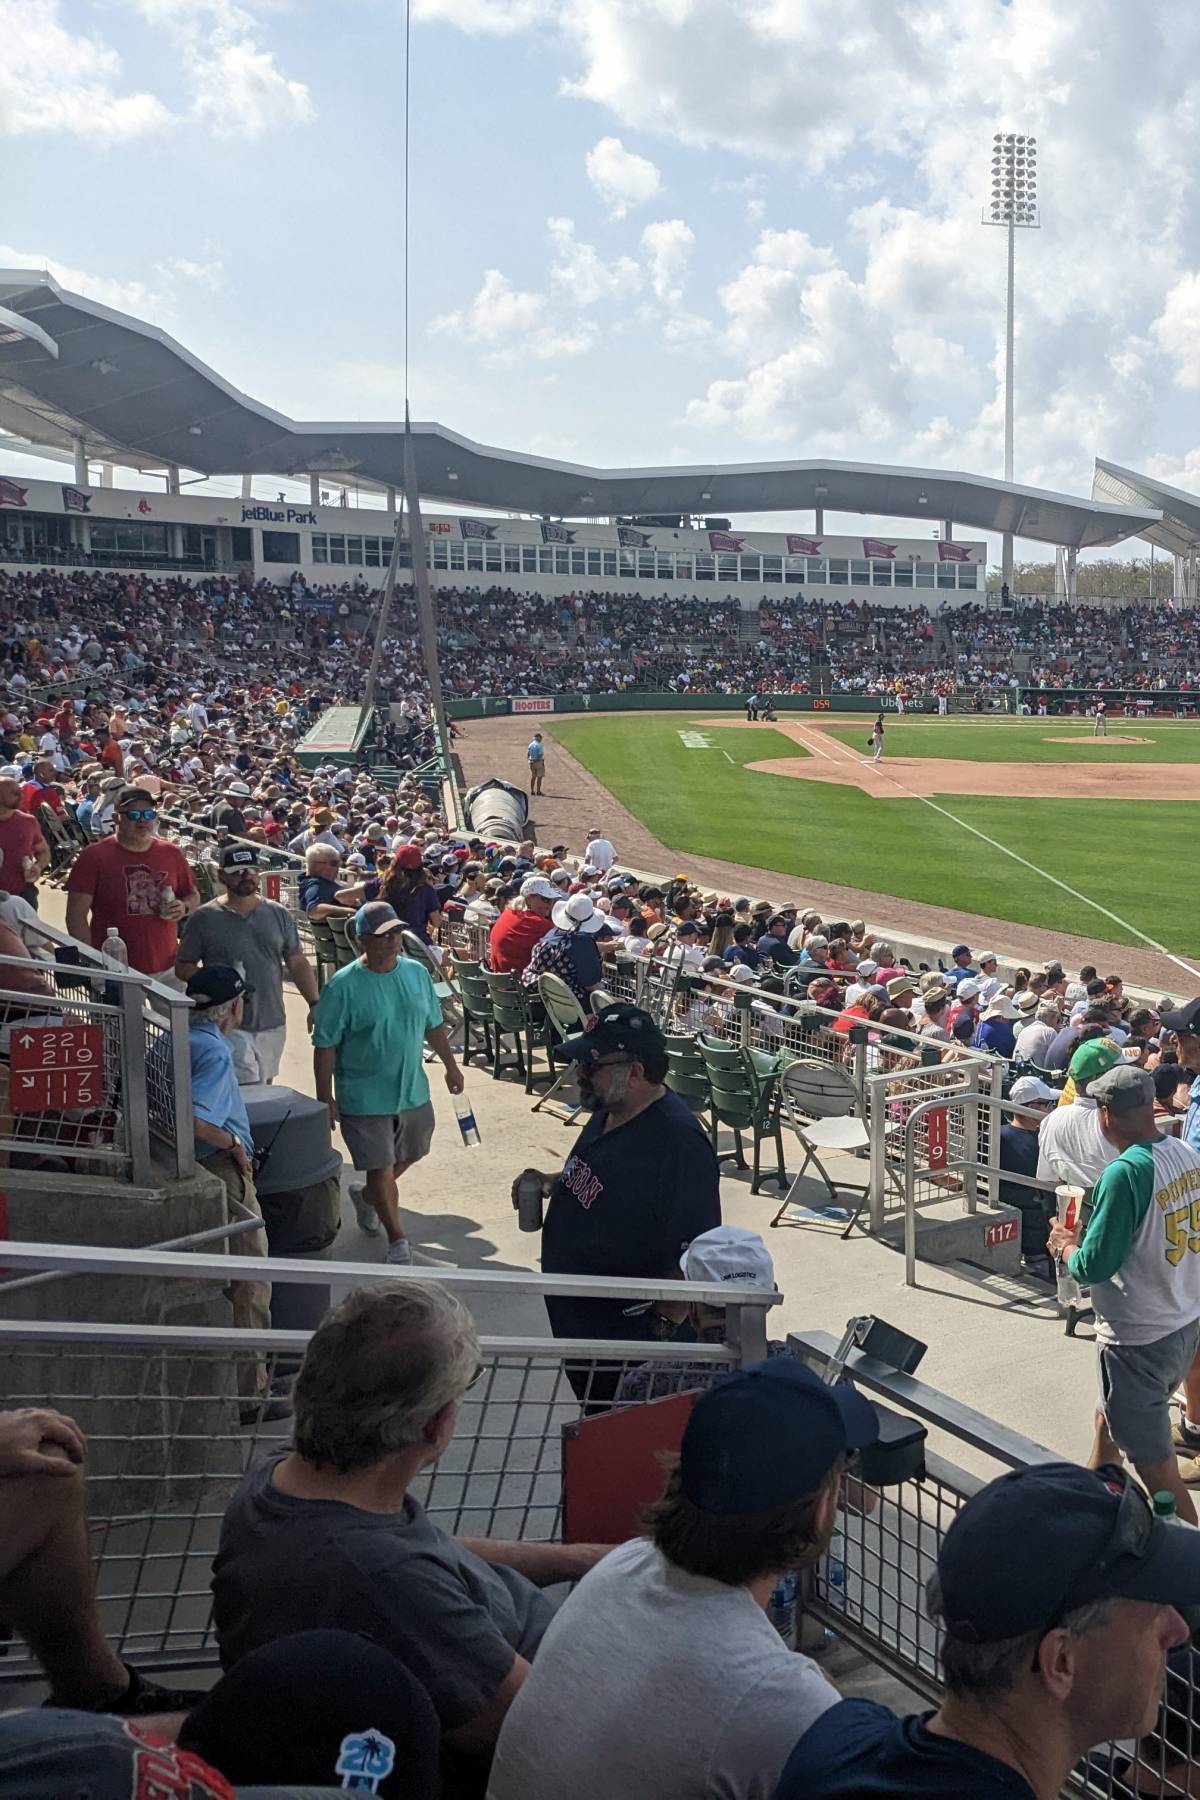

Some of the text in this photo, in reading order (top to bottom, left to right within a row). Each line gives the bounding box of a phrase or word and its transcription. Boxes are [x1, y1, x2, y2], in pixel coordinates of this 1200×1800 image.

[241, 505, 317, 524] jetBlue Park
[514, 701, 551, 710] HOOTERS
[42, 1031, 87, 1048] 221
[42, 1048, 93, 1065] 219
[47, 1072, 92, 1090] 117
[47, 1089, 92, 1106] 115
[762, 1120, 771, 1129] 12
[932, 1115, 943, 1160] 119
[989, 1223, 1013, 1243] 117
